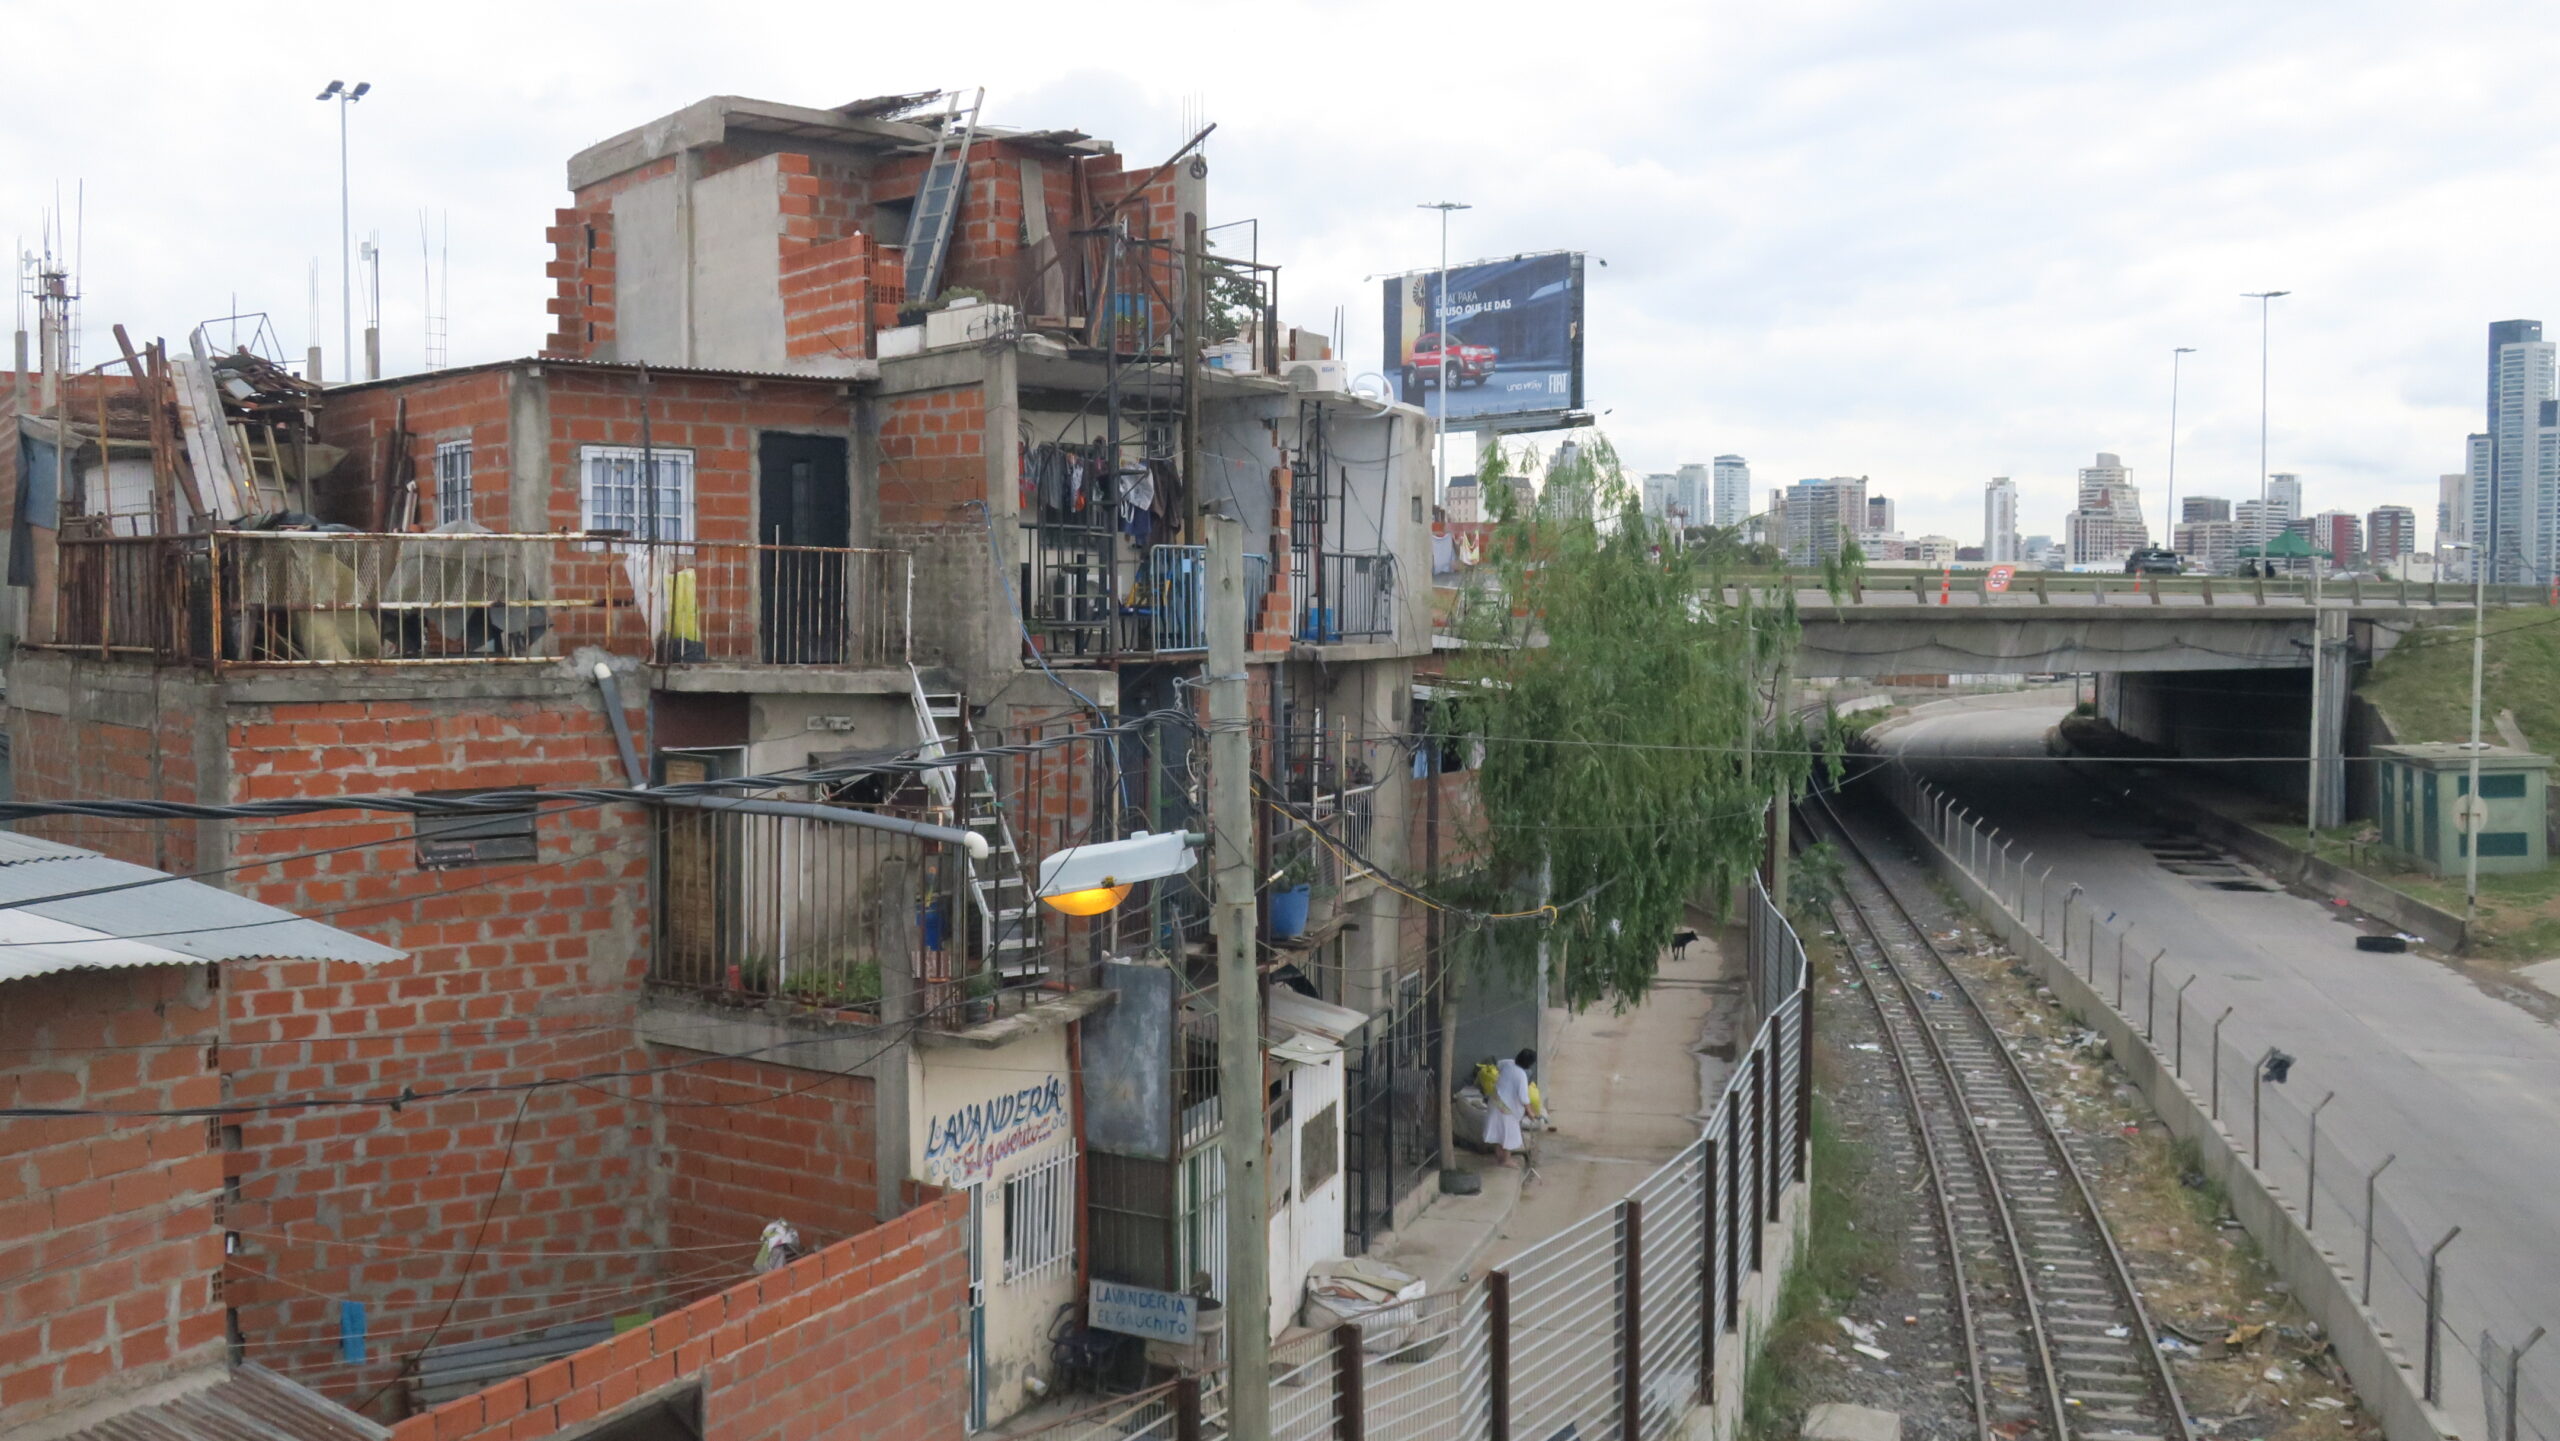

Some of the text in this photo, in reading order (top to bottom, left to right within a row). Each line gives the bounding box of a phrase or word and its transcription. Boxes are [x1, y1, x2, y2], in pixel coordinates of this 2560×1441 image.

[1458, 290, 1478, 303] PARA
[1446, 305, 1462, 316] USO
[1465, 303, 1481, 313] QUE
[1484, 301, 1492, 311] LE
[1494, 299, 1511, 310] DAS
[1549, 373, 1567, 393] FIAT
[924, 1074, 1061, 1160] LAVANDERÍA
[1096, 1286, 1187, 1316] LAVANDERIA
